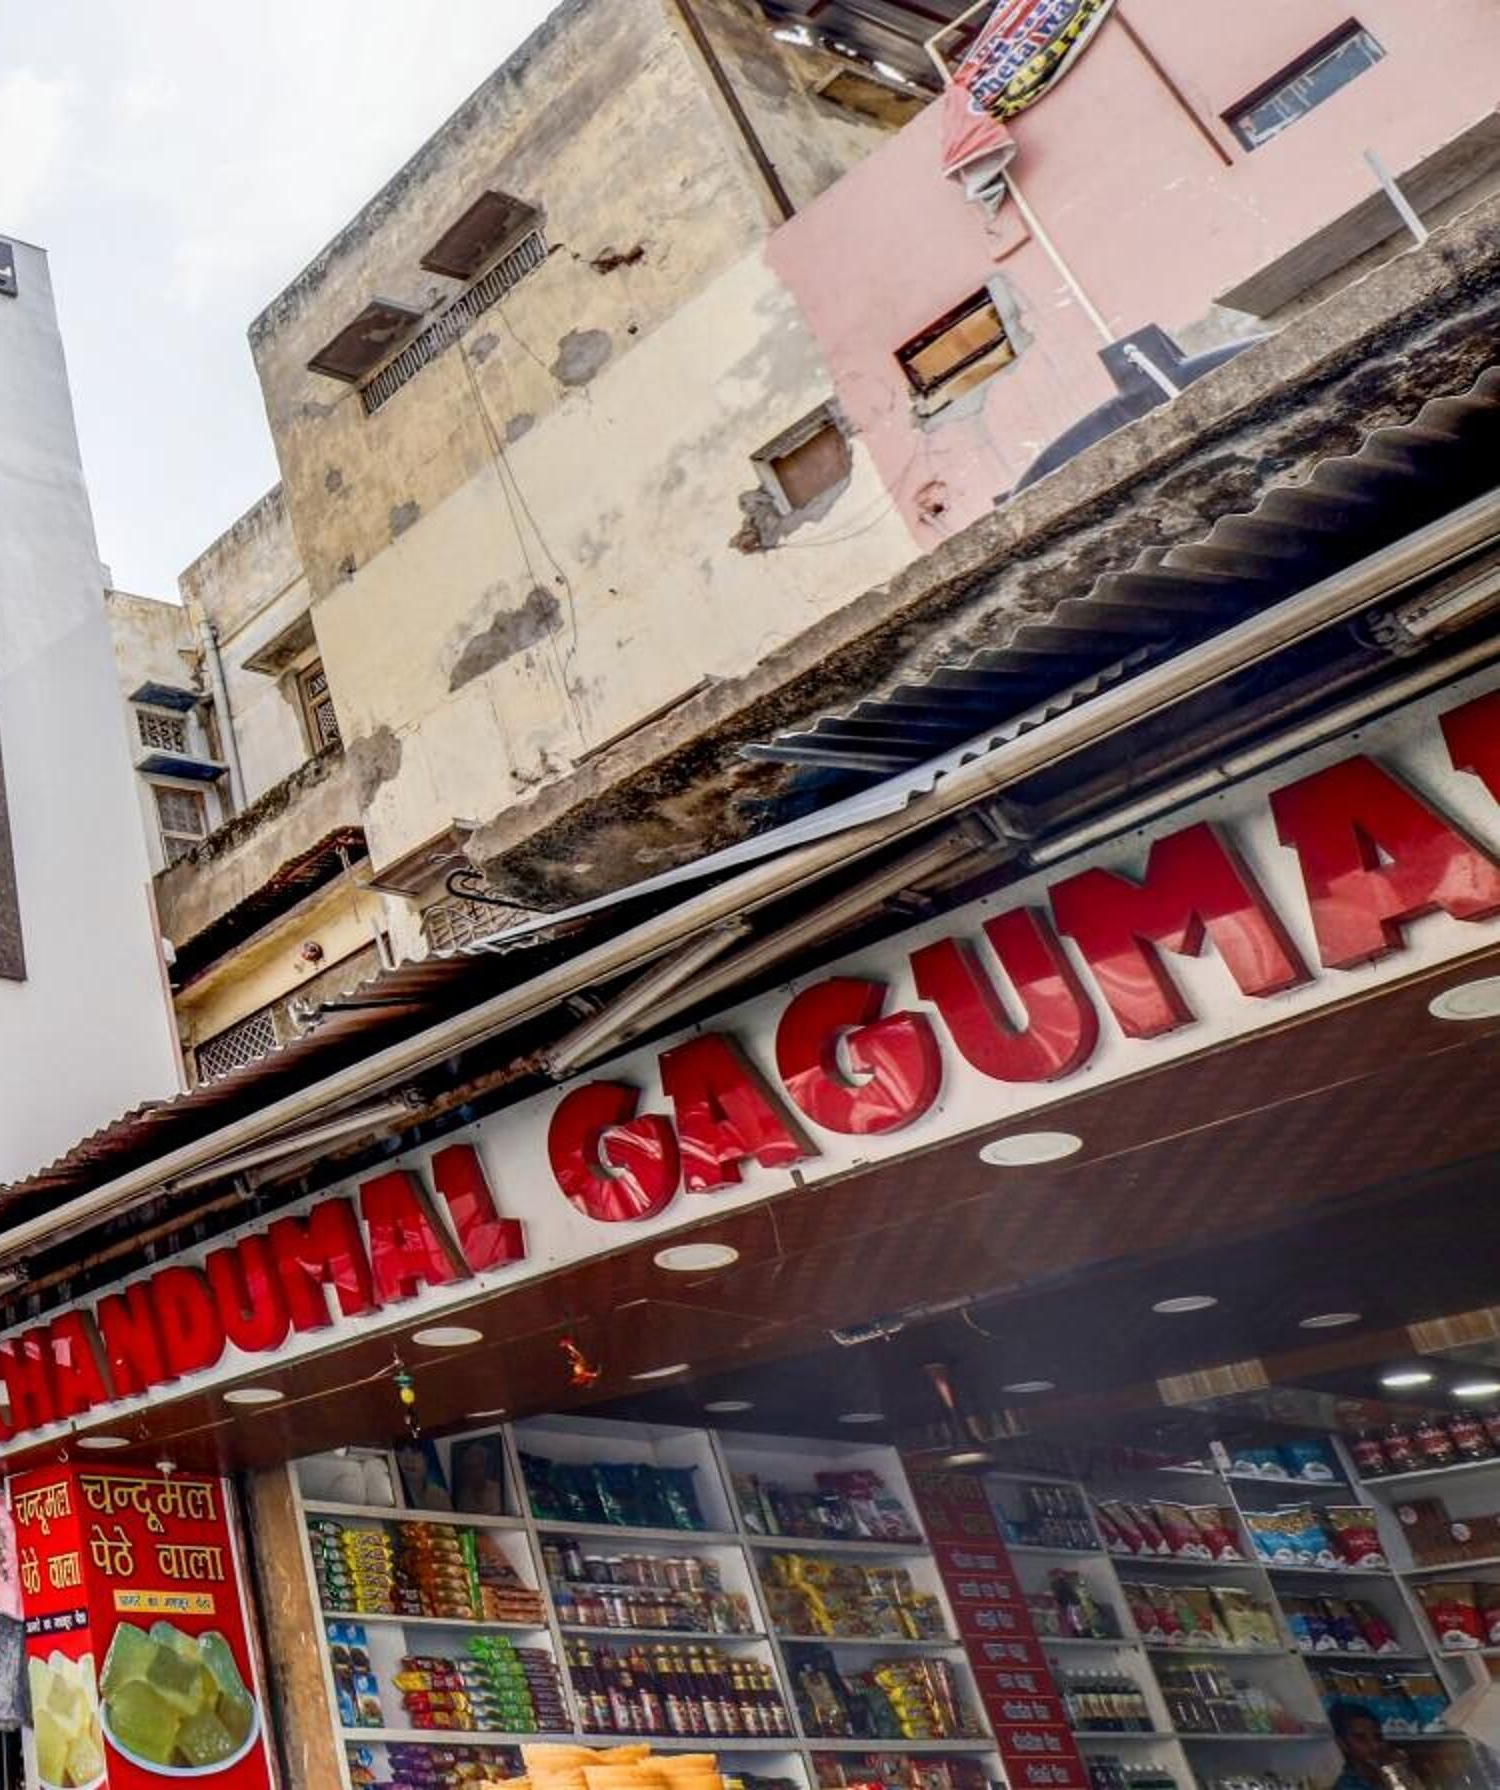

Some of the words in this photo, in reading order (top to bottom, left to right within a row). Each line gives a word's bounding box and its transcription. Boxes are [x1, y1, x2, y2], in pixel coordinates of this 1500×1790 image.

[80, 1474, 217, 1533] चन्दूमल
[21, 1546, 41, 1594] पेठे
[47, 1552, 82, 1590] वाला
[90, 1524, 134, 1577] पेठे
[155, 1543, 226, 1581] वाला
